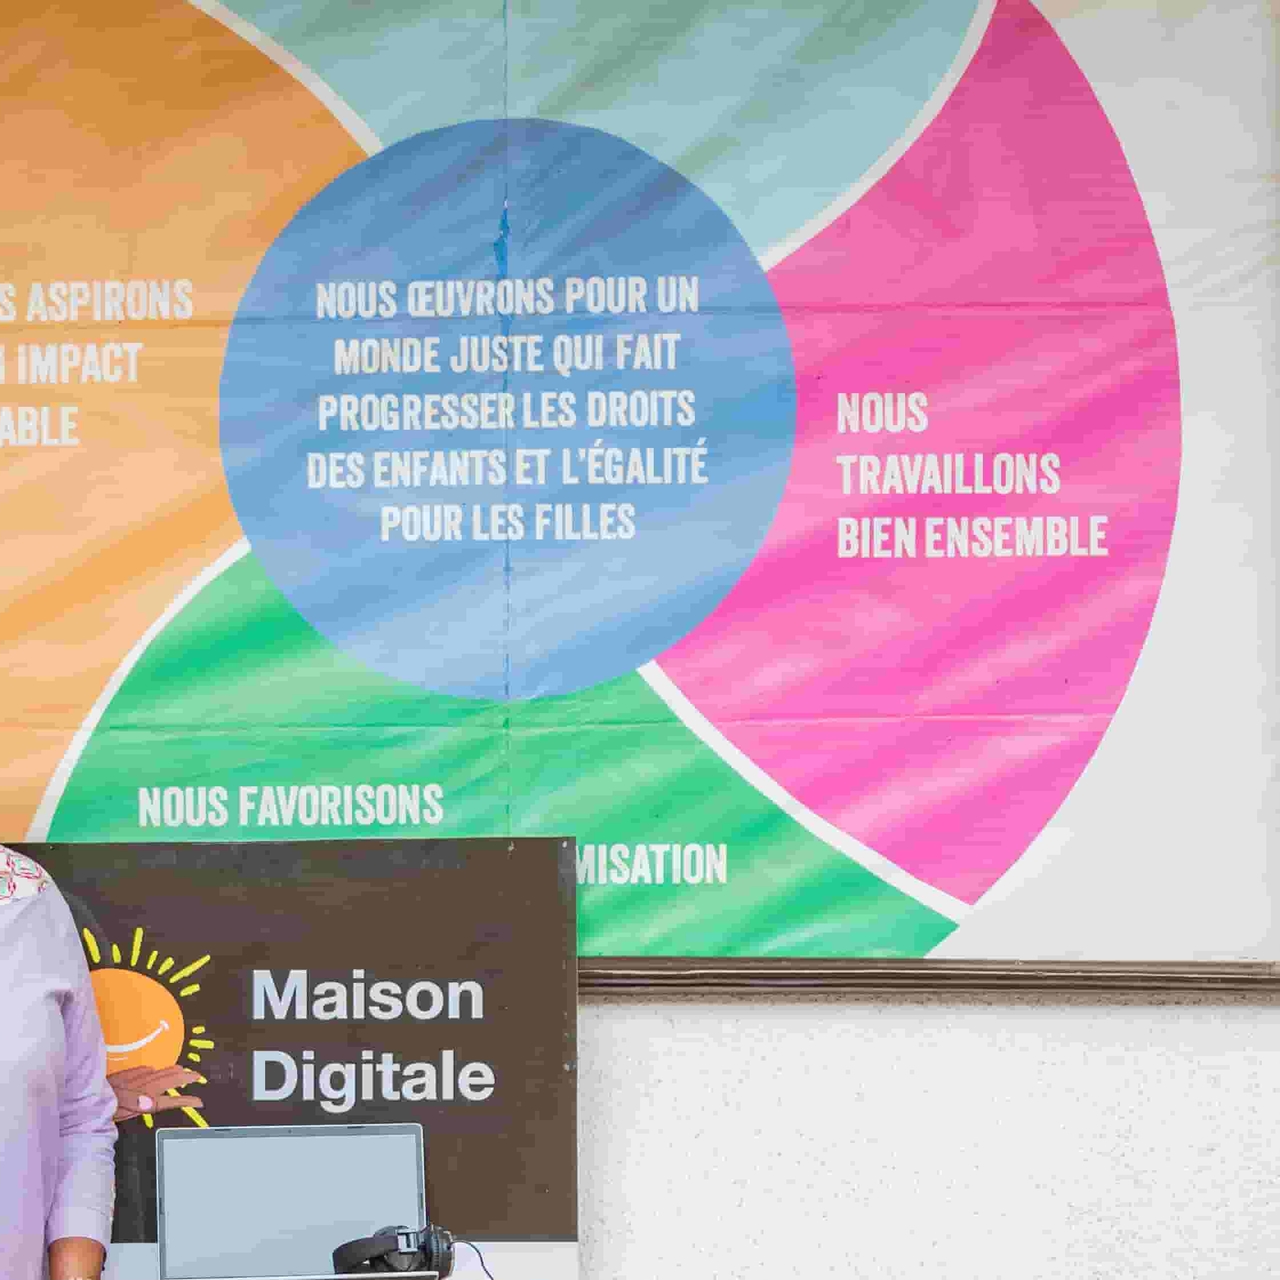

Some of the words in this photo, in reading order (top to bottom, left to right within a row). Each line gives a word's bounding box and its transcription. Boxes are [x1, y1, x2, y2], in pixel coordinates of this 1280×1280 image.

[26, 279, 193, 322] ASPIRONS
[316, 281, 397, 318] NOUS
[407, 279, 555, 317] ŒUVRONS
[565, 277, 647, 314] POUR
[657, 276, 699, 313] UN
[18, 343, 143, 384] IMPACT
[334, 337, 441, 374] MONDE
[450, 335, 544, 373] JUSTE
[553, 334, 604, 376] QUI
[617, 334, 681, 370] FAIT
[319, 393, 515, 431] PROGRESSER
[524, 392, 576, 428] LES
[587, 390, 695, 427] DROITS
[837, 392, 928, 433] NOUS
[308, 453, 365, 488] DES
[374, 450, 507, 488] ENFANTS
[516, 449, 551, 486] ET
[562, 438, 709, 485] L'ÉGALITÉ
[836, 453, 1061, 494] TRAVAILLONS
[381, 505, 463, 541] POUR
[472, 504, 524, 540] LES
[535, 503, 636, 540] FILLES
[837, 517, 916, 558] BIEN
[925, 515, 1109, 557] ENSEMBLE
[138, 786, 228, 827] NOUS
[239, 784, 444, 826] FAVORISONS
[252, 969, 483, 1019] Maison
[253, 1049, 495, 1112] Digitale
